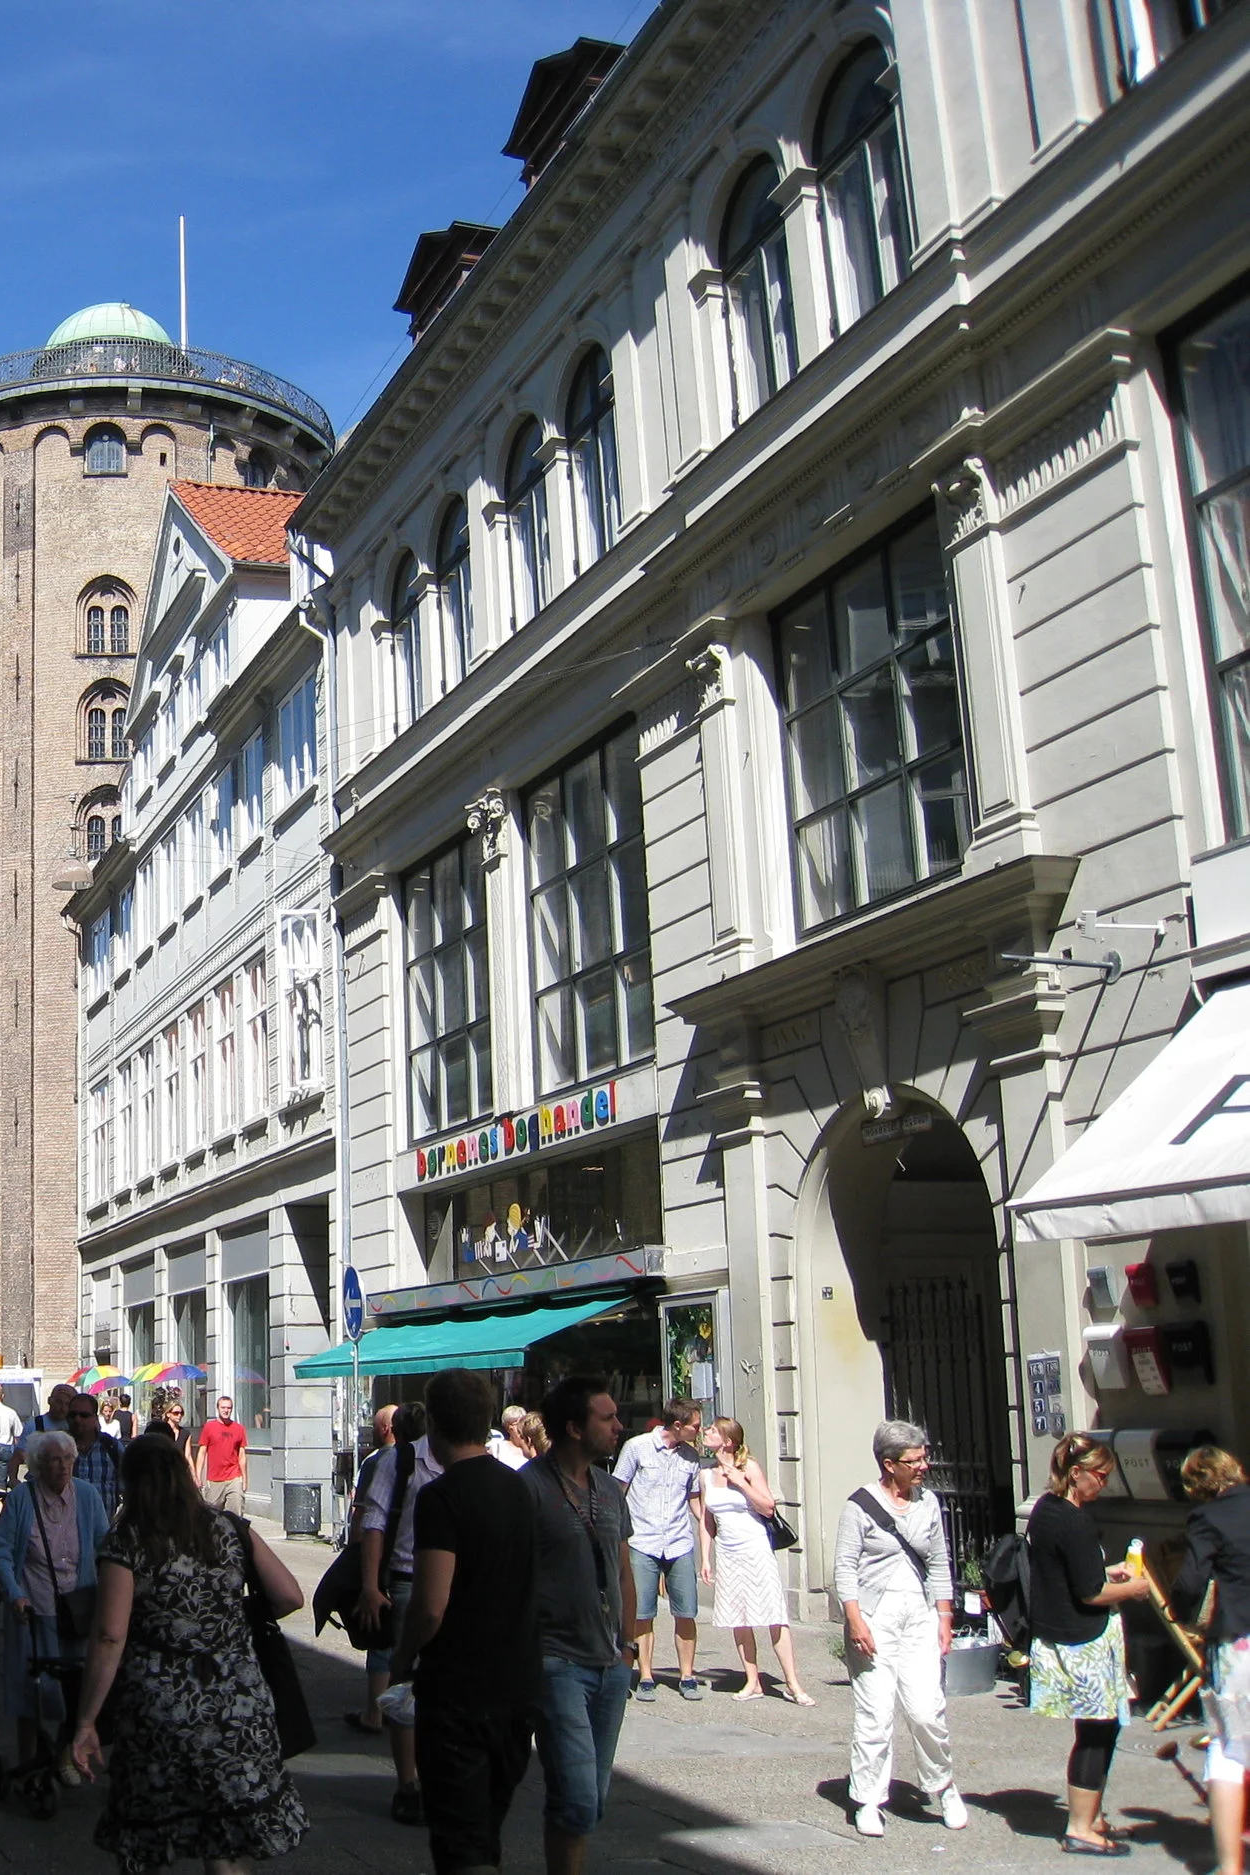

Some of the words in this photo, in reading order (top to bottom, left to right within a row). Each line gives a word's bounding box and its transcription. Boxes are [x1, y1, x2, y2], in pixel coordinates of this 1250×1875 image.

[416, 1127, 498, 1182] børnenes
[502, 1080, 616, 1157] boghandel
[1172, 1341, 1193, 1352] POST
[1124, 1458, 1150, 1468] POST
